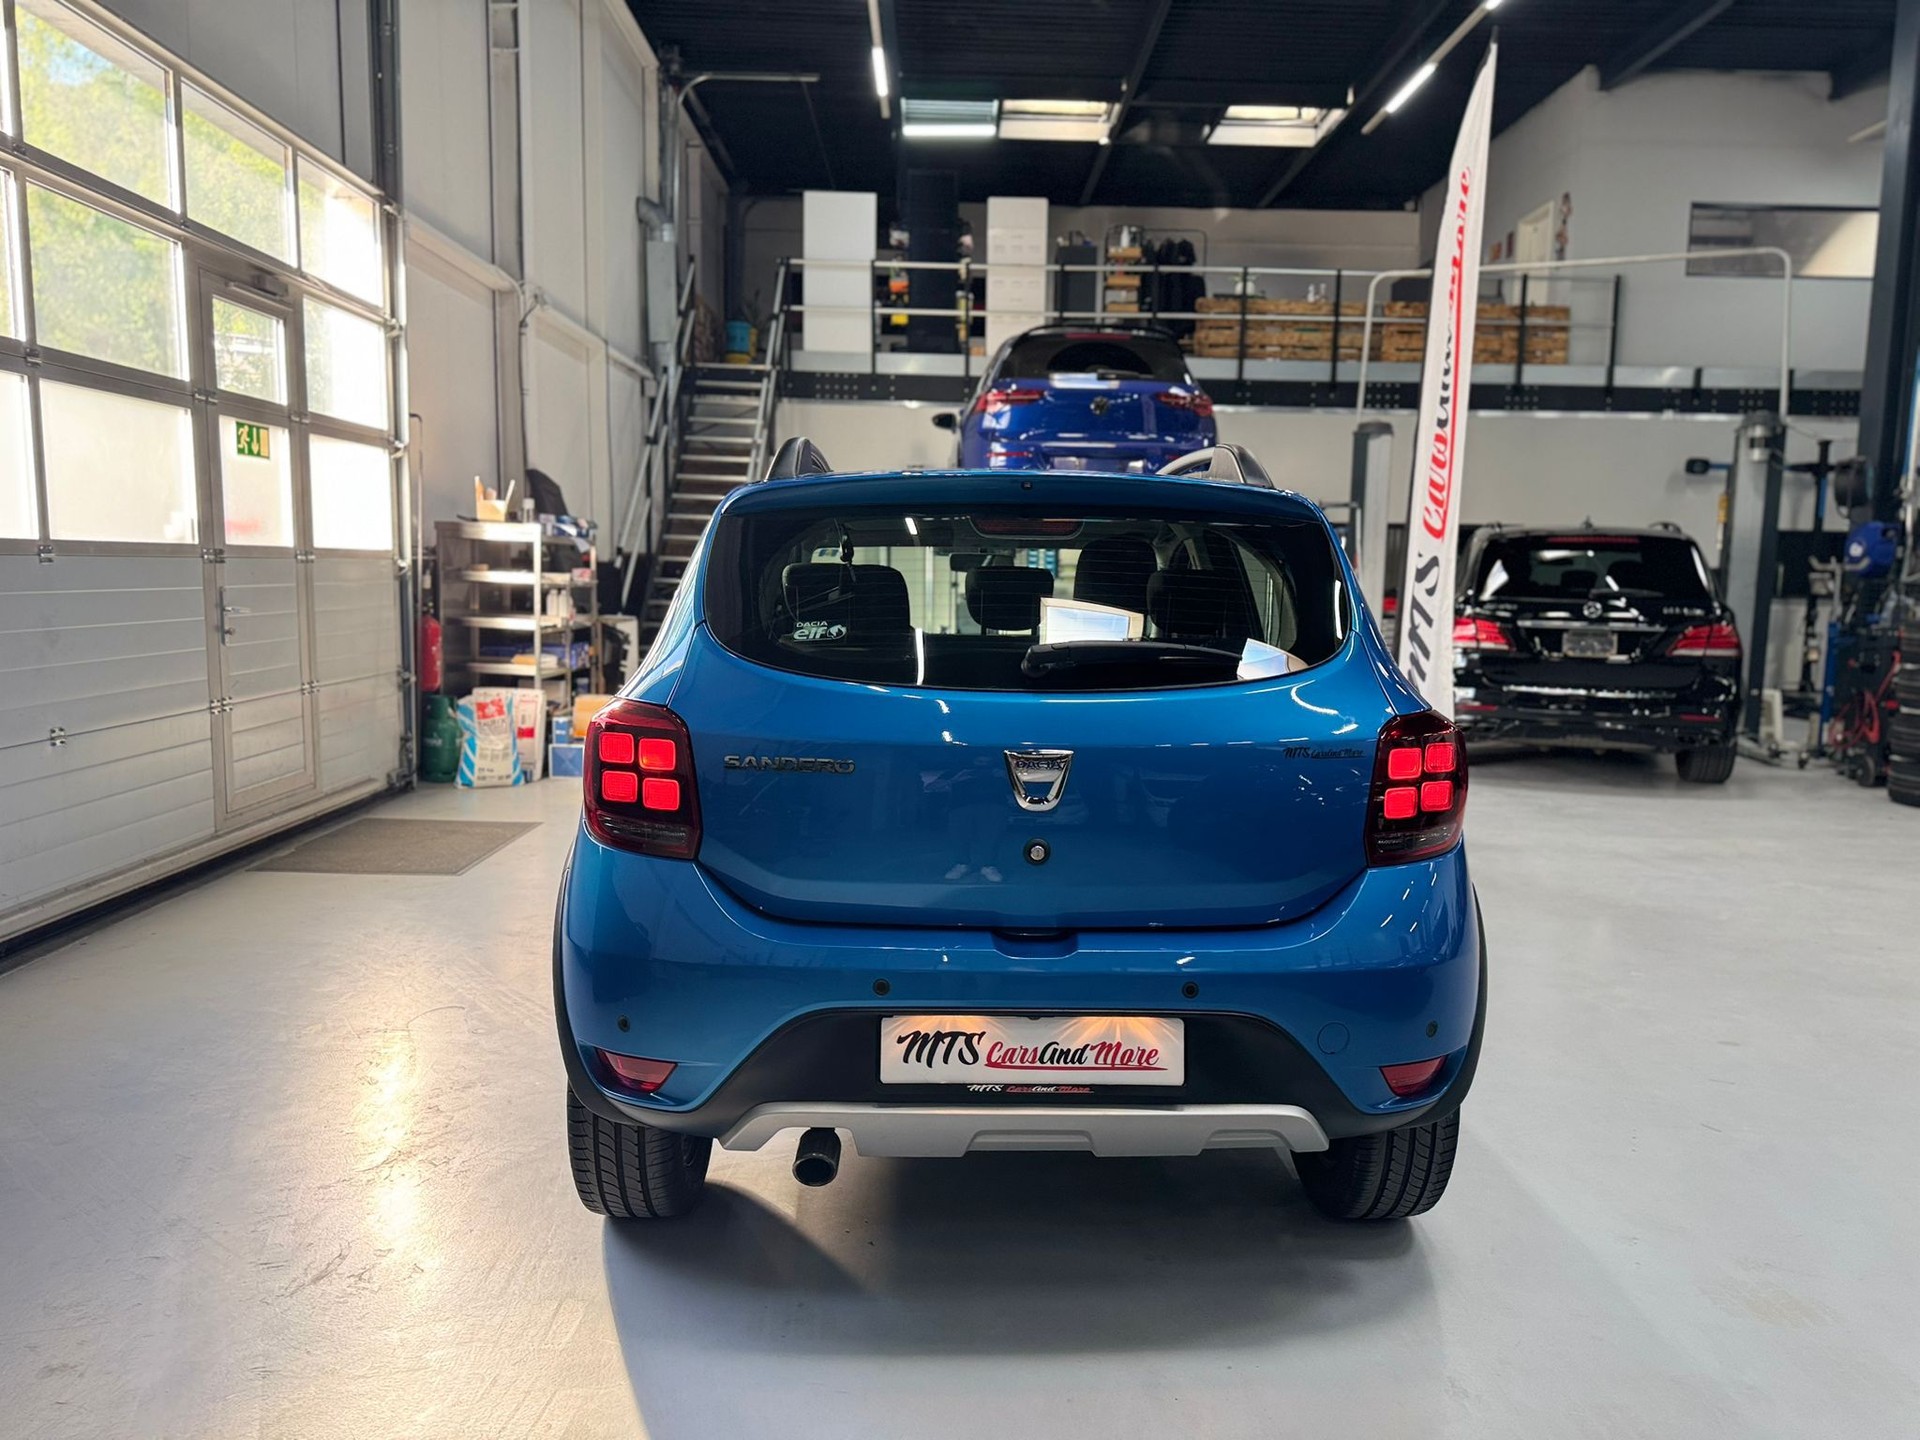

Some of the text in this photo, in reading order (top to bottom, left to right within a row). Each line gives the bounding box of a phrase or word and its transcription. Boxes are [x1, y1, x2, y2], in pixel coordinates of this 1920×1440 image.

[796, 620, 828, 628] DACIA
[793, 626, 828, 640] elf
[723, 755, 856, 774] SANDERO
[1015, 760, 1062, 770] DACIA
[897, 1030, 986, 1068] MTS
[967, 1084, 1004, 1092] MTS
